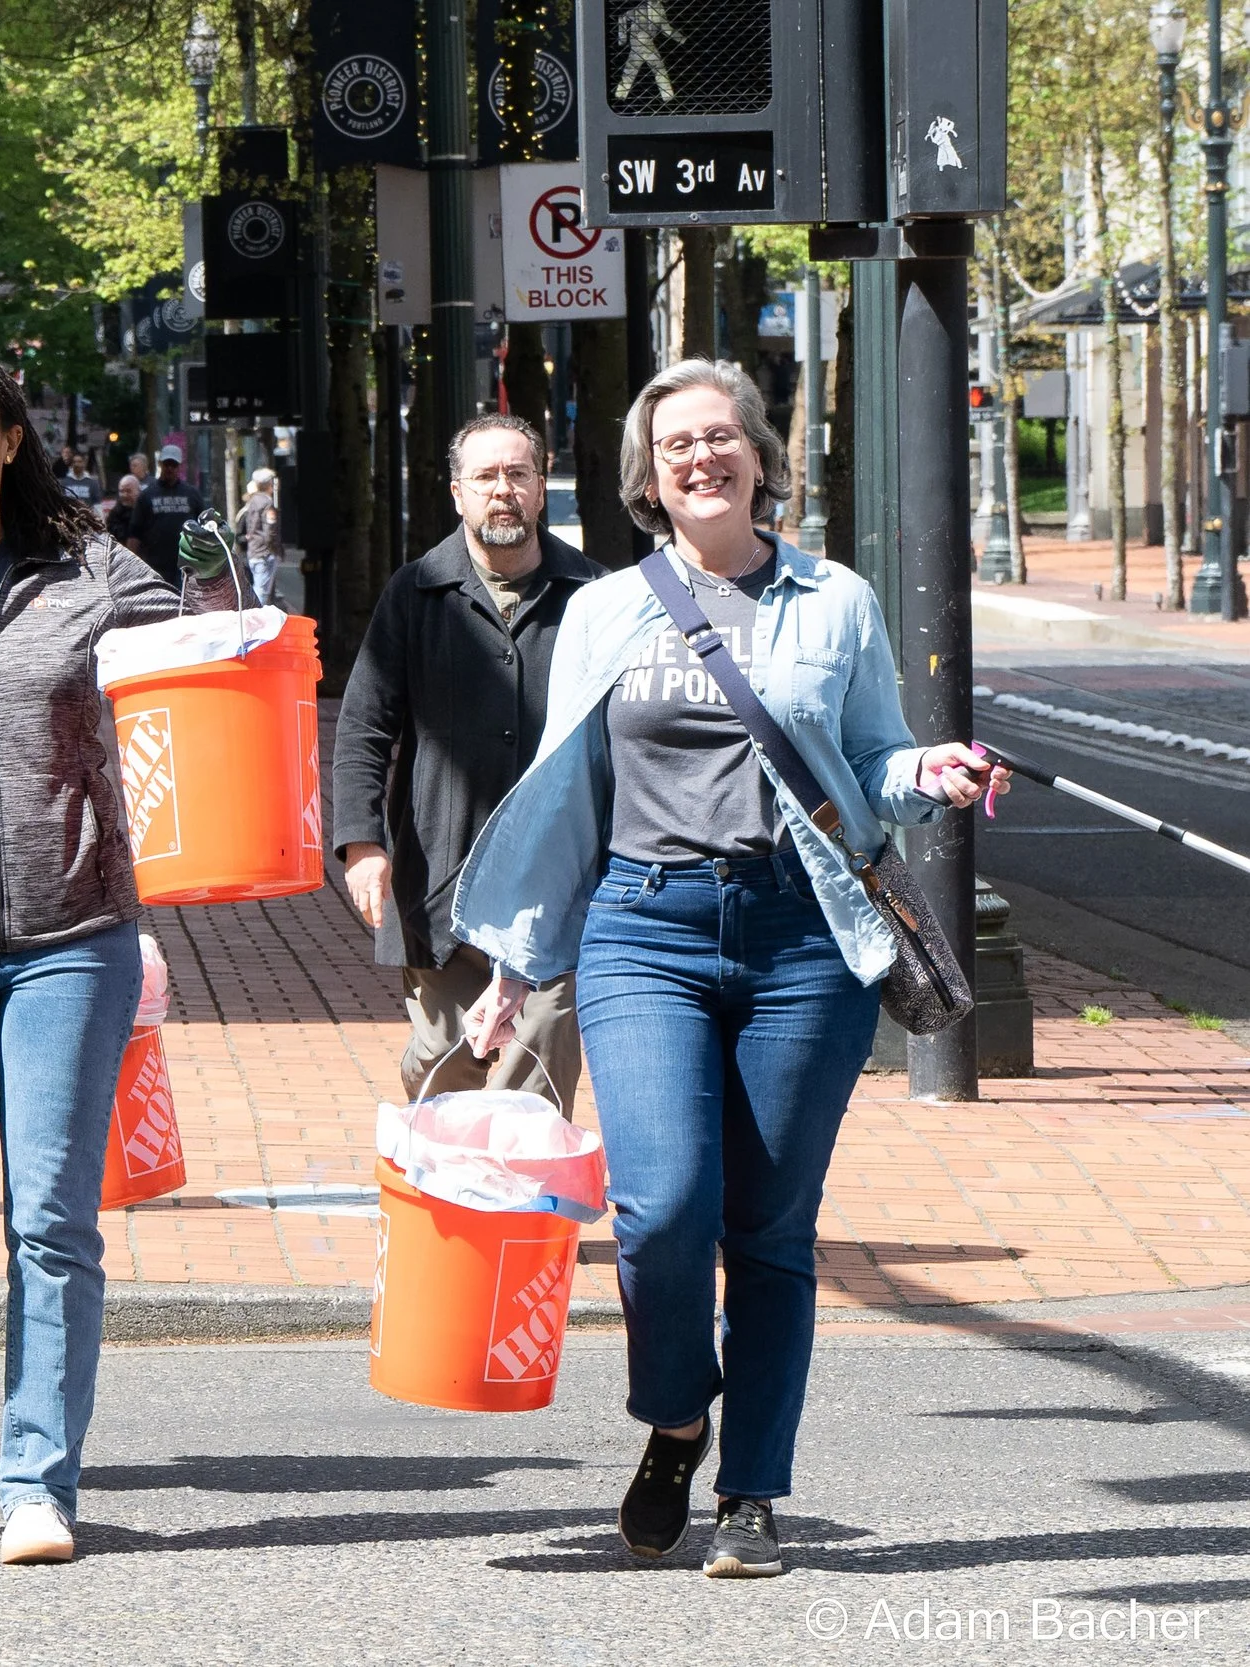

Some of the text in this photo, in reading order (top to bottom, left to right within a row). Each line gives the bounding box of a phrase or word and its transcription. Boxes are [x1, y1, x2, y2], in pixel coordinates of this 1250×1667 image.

[328, 61, 401, 112] PIONEER DISTRICT
[347, 117, 385, 130] PORTLAND
[618, 158, 766, 195] SW 3rd Av
[541, 266, 594, 285] THIS
[527, 287, 608, 308] BLOCK
[47, 599, 73, 608] PNC
[621, 668, 655, 702] IN
[512, 1254, 565, 1312] THE
